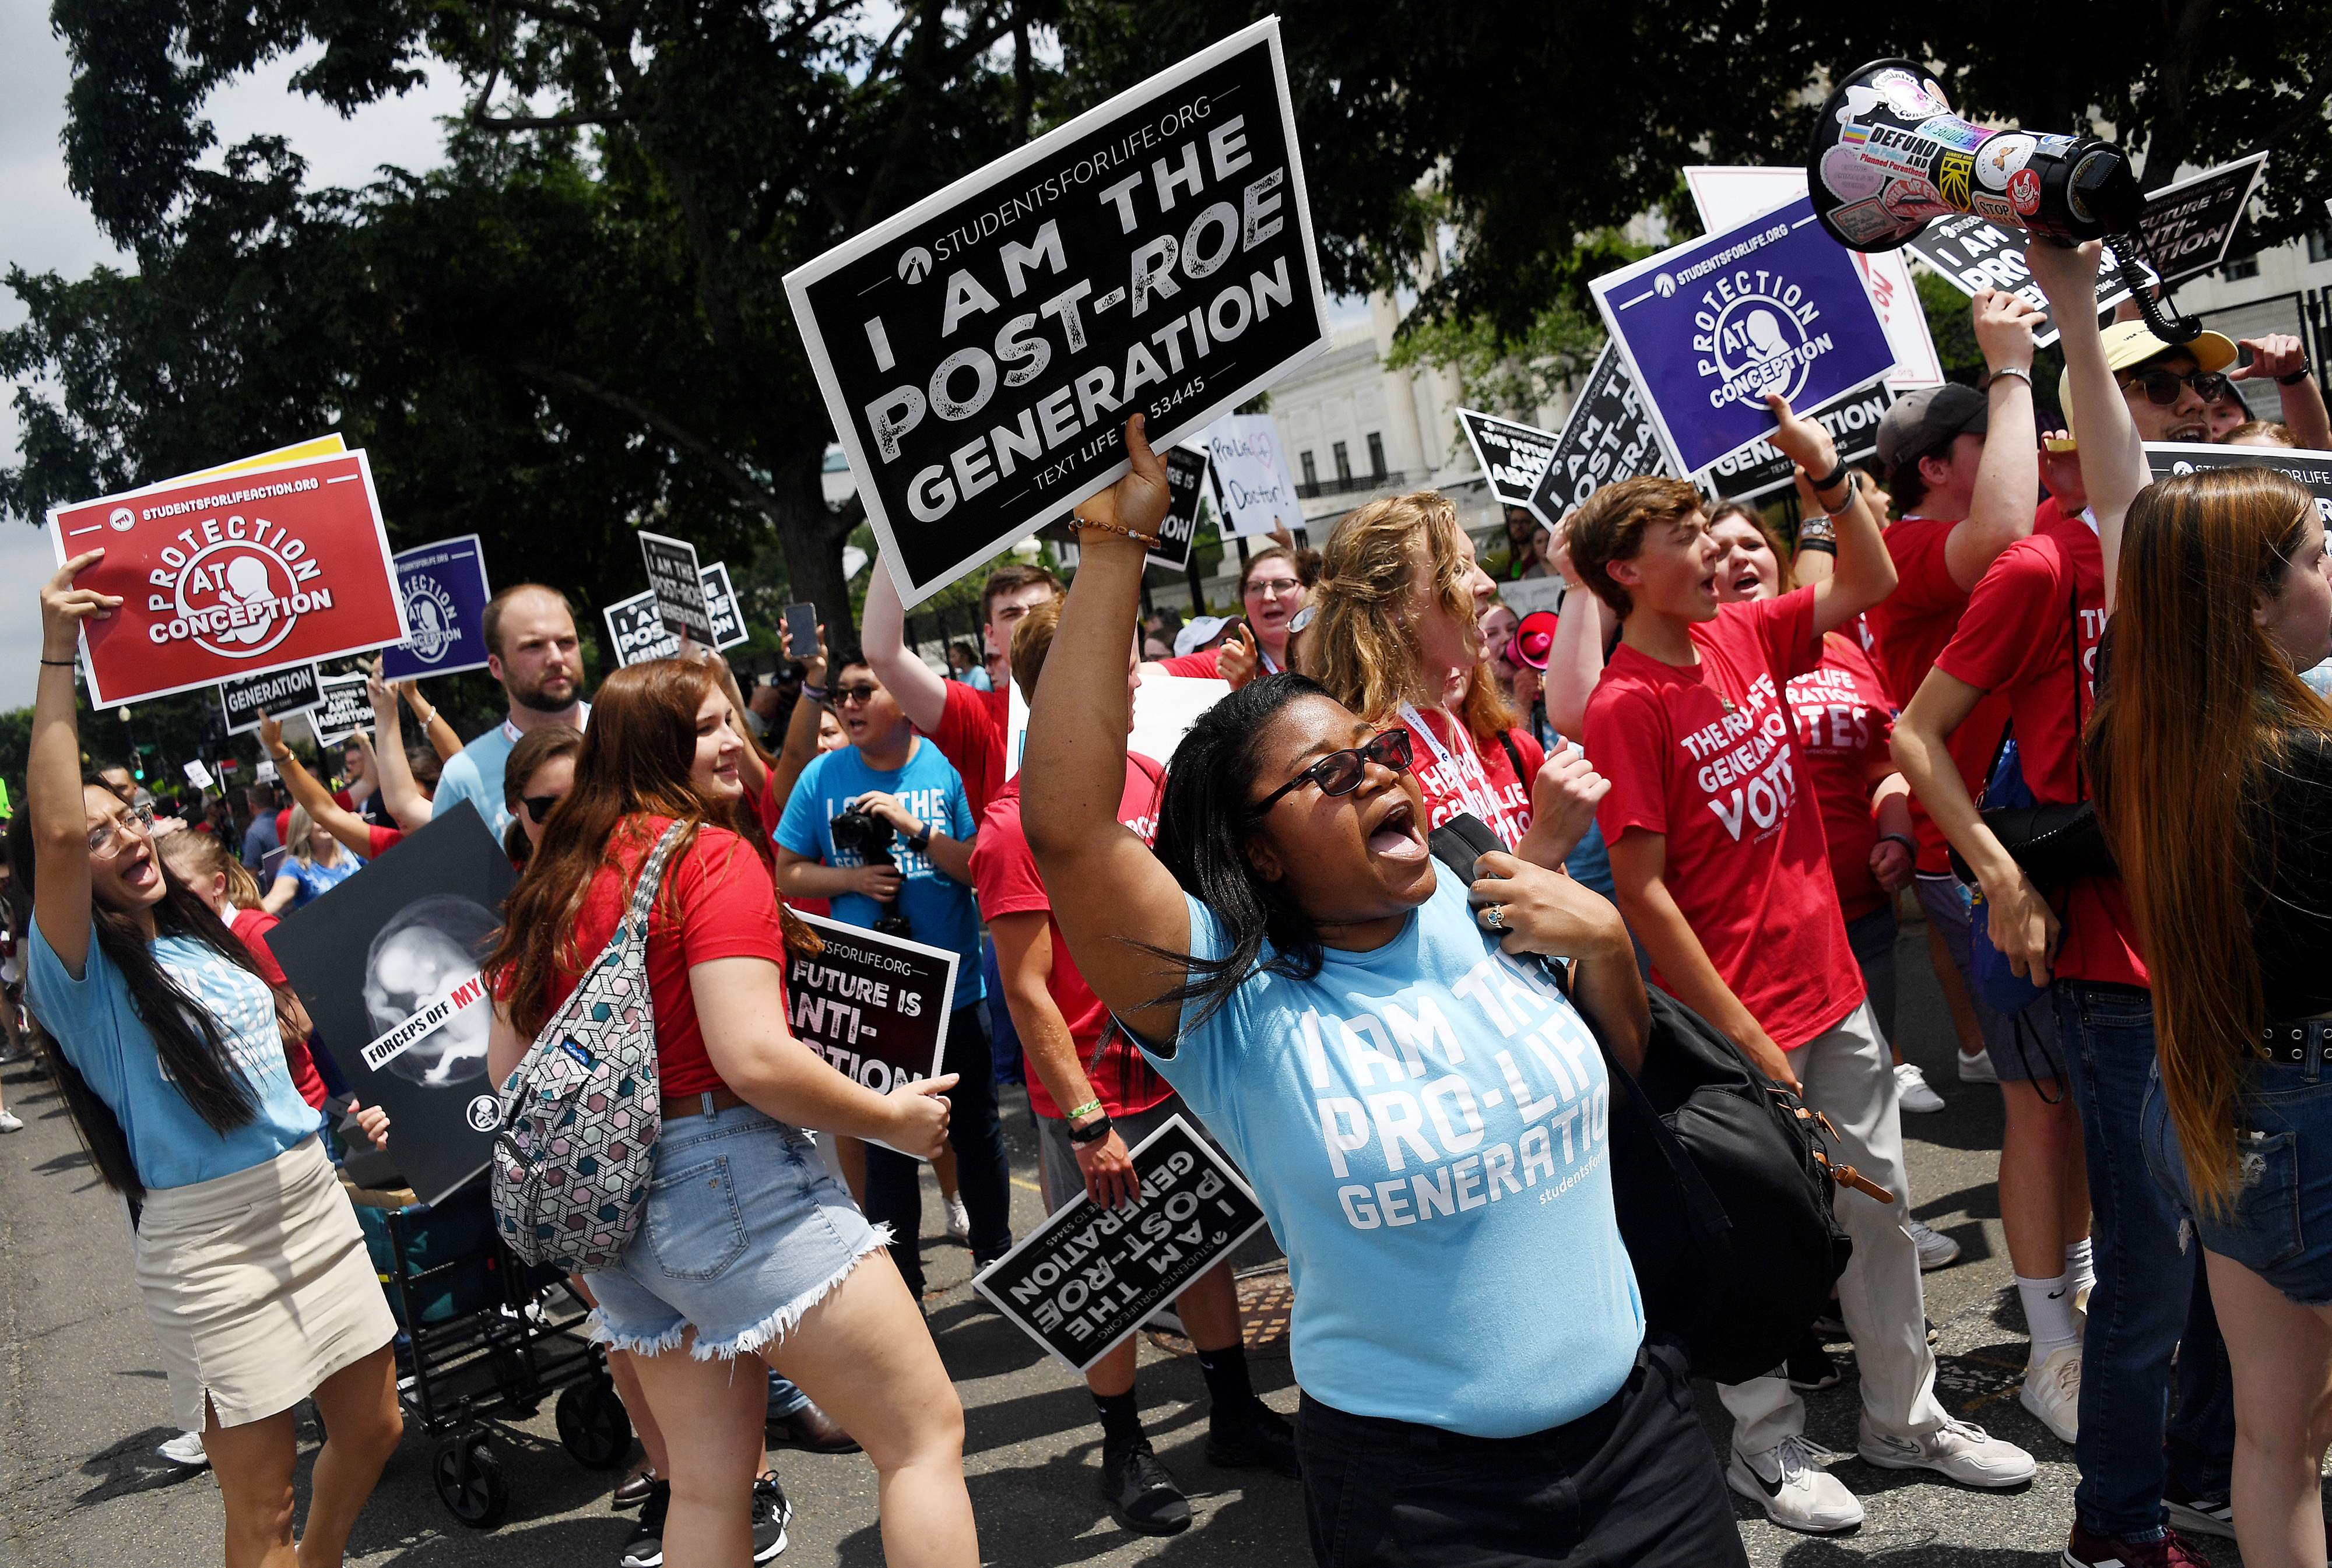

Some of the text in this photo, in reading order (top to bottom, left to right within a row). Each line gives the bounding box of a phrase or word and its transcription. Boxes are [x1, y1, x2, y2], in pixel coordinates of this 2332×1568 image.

[1860, 153, 1888, 167] Planned
[1890, 162, 1927, 178] Parenthood
[1870, 127, 1938, 158] DEFUND
[1906, 154, 1929, 168] AND
[936, 96, 1211, 261] STUDENTSFORLIFE.ORG
[1979, 201, 2010, 216] STOP
[2139, 195, 2211, 230] FUTURE
[2215, 187, 2235, 203] IS
[864, 114, 1252, 372] I AM THE
[1676, 223, 1789, 286] STUDENTSFORLIFE.ORG
[1958, 224, 2010, 258] AM
[865, 167, 1283, 463] POST-ROE
[1692, 270, 1820, 377] PROTECTION
[1722, 319, 1748, 356] AT
[907, 256, 1293, 522] GENERATION
[1709, 332, 1835, 410] CONCEPTION
[1032, 377, 1206, 487] TEXT LIFE 53445
[1567, 414, 1603, 483] AM
[142, 477, 319, 521] STUDENTSFORLIFEACTION.ORG
[149, 515, 321, 611] PROTECTION
[192, 561, 227, 595] AT
[149, 587, 333, 644] CONCEPTION
[409, 603, 422, 621] AT
[228, 668, 312, 712] GENERATION
[1680, 722, 1730, 762] THE
[792, 959, 922, 1017] FUTURE IS
[368, 976, 482, 1062] FORCEPS OFF MY
[1301, 1010, 1331, 1089] I
[1339, 994, 1466, 1088] AM
[1032, 1169, 1225, 1334] POST-ROE
[1046, 1221, 1079, 1246] 53445
[1065, 1200, 1236, 1341] I AM THE
[1097, 1242, 1214, 1340] STUDENTSFORLIFE.ORG
